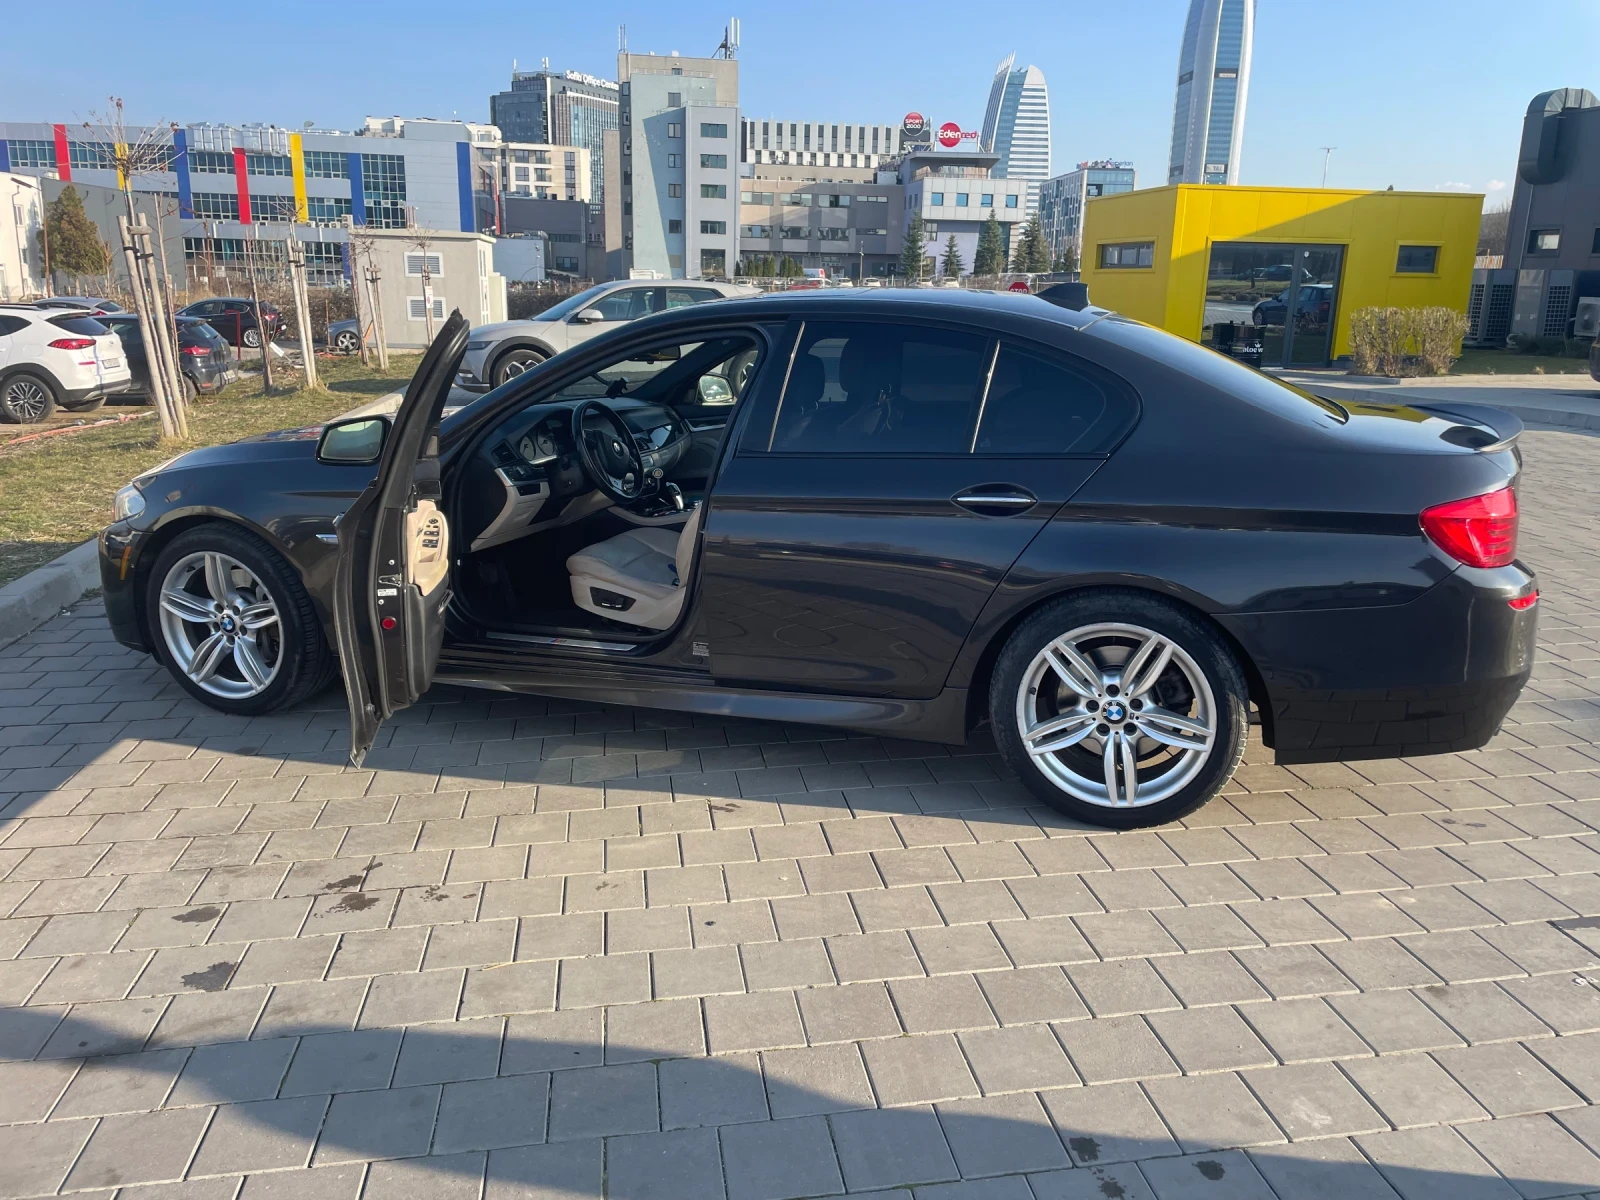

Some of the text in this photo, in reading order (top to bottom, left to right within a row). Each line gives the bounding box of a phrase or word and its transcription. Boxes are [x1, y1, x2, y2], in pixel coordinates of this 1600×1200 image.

[566, 70, 582, 81] Sofia
[583, 74, 600, 86] Office
[938, 129, 978, 139] Edenred
